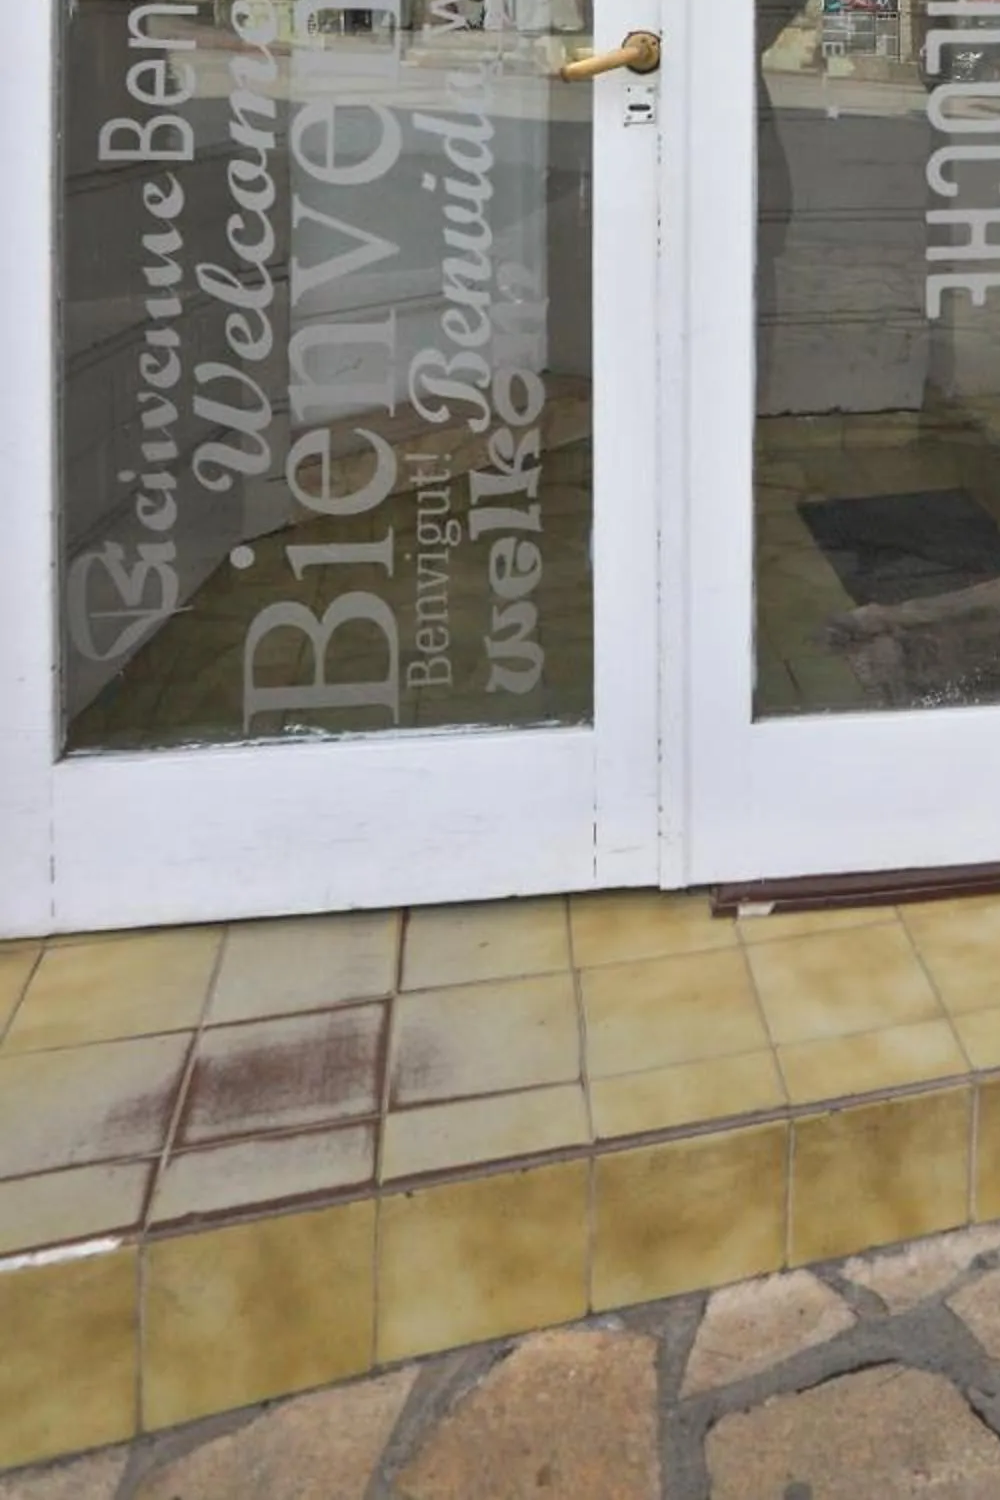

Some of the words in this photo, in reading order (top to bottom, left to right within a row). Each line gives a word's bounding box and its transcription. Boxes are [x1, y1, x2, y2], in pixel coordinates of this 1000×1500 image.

[69, 173, 193, 661] Bienvenue
[404, 451, 462, 689] Benvigut!
[468, 257, 546, 694] welkom
